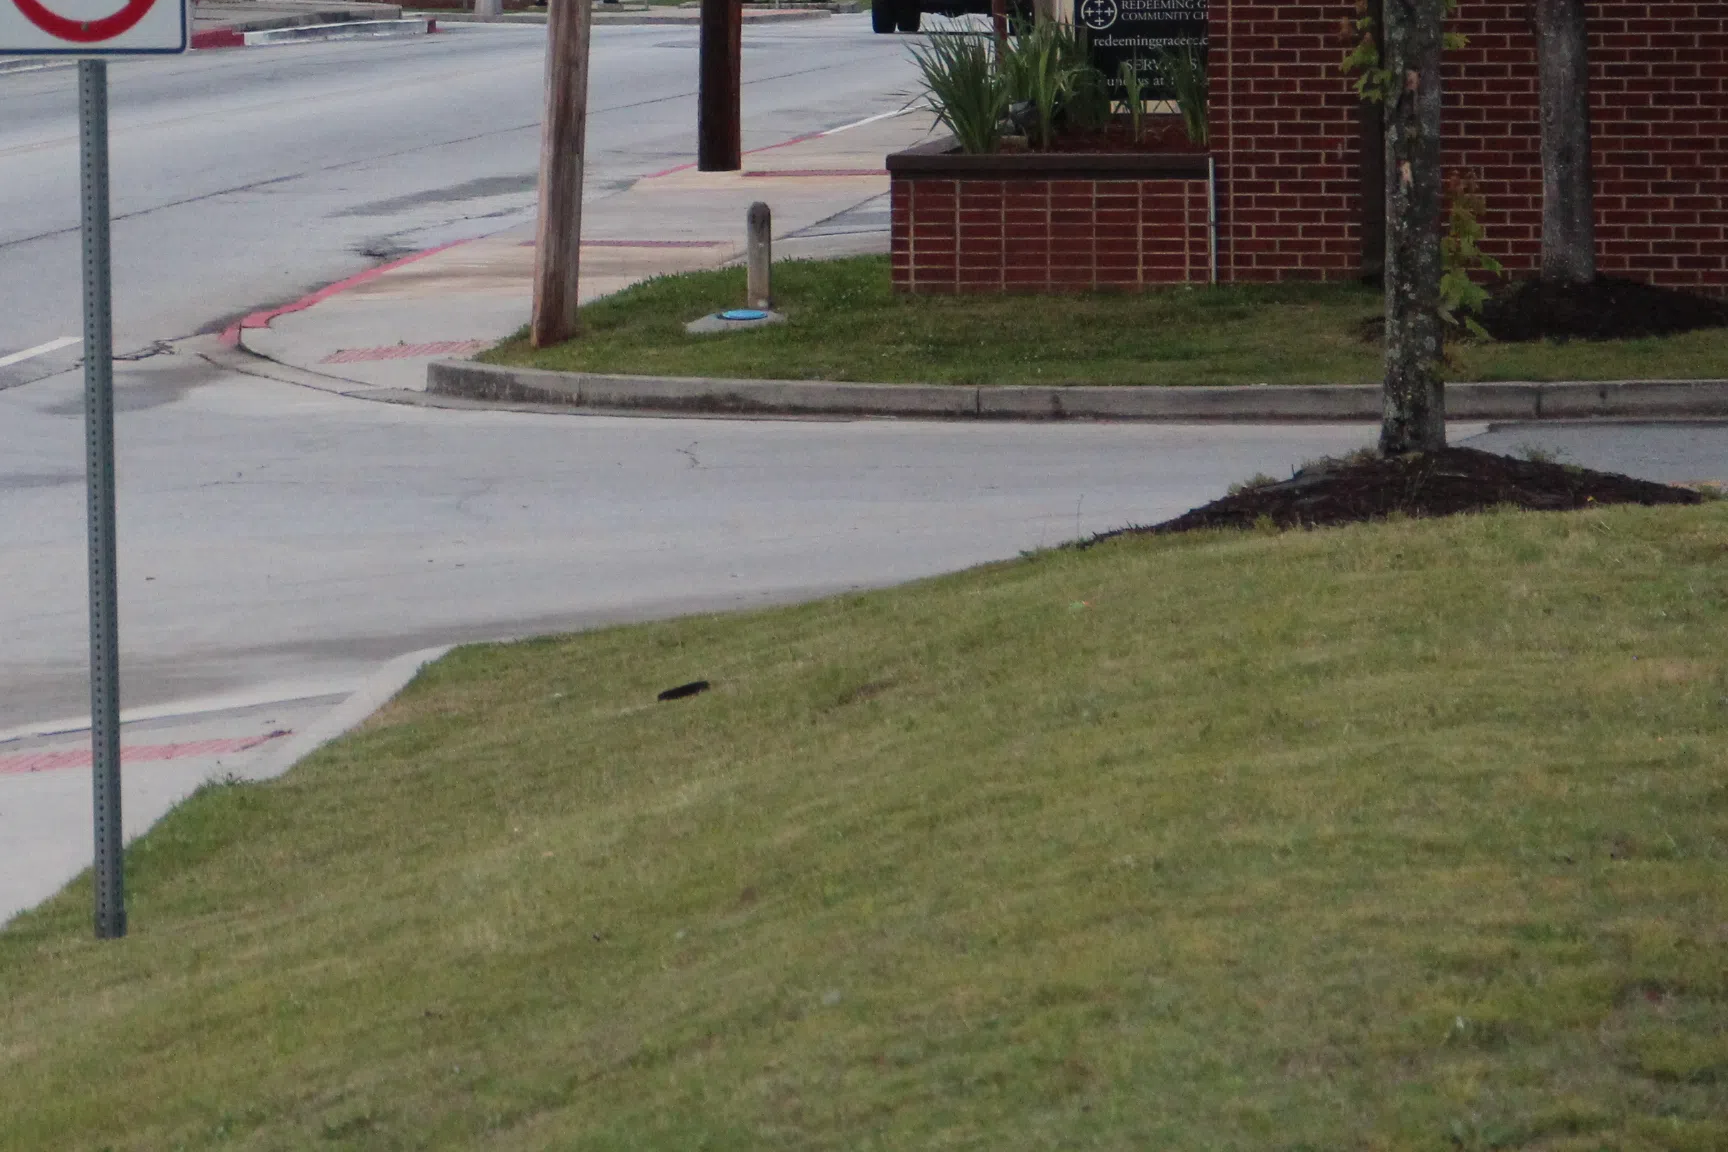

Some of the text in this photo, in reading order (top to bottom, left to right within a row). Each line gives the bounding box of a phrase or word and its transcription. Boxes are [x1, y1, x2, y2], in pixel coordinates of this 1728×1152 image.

[1121, 0, 1194, 10] REDEEMING
[1121, 11, 1191, 21] COMMUNITY
[1093, 33, 1209, 50] redeeminggracecc.c
